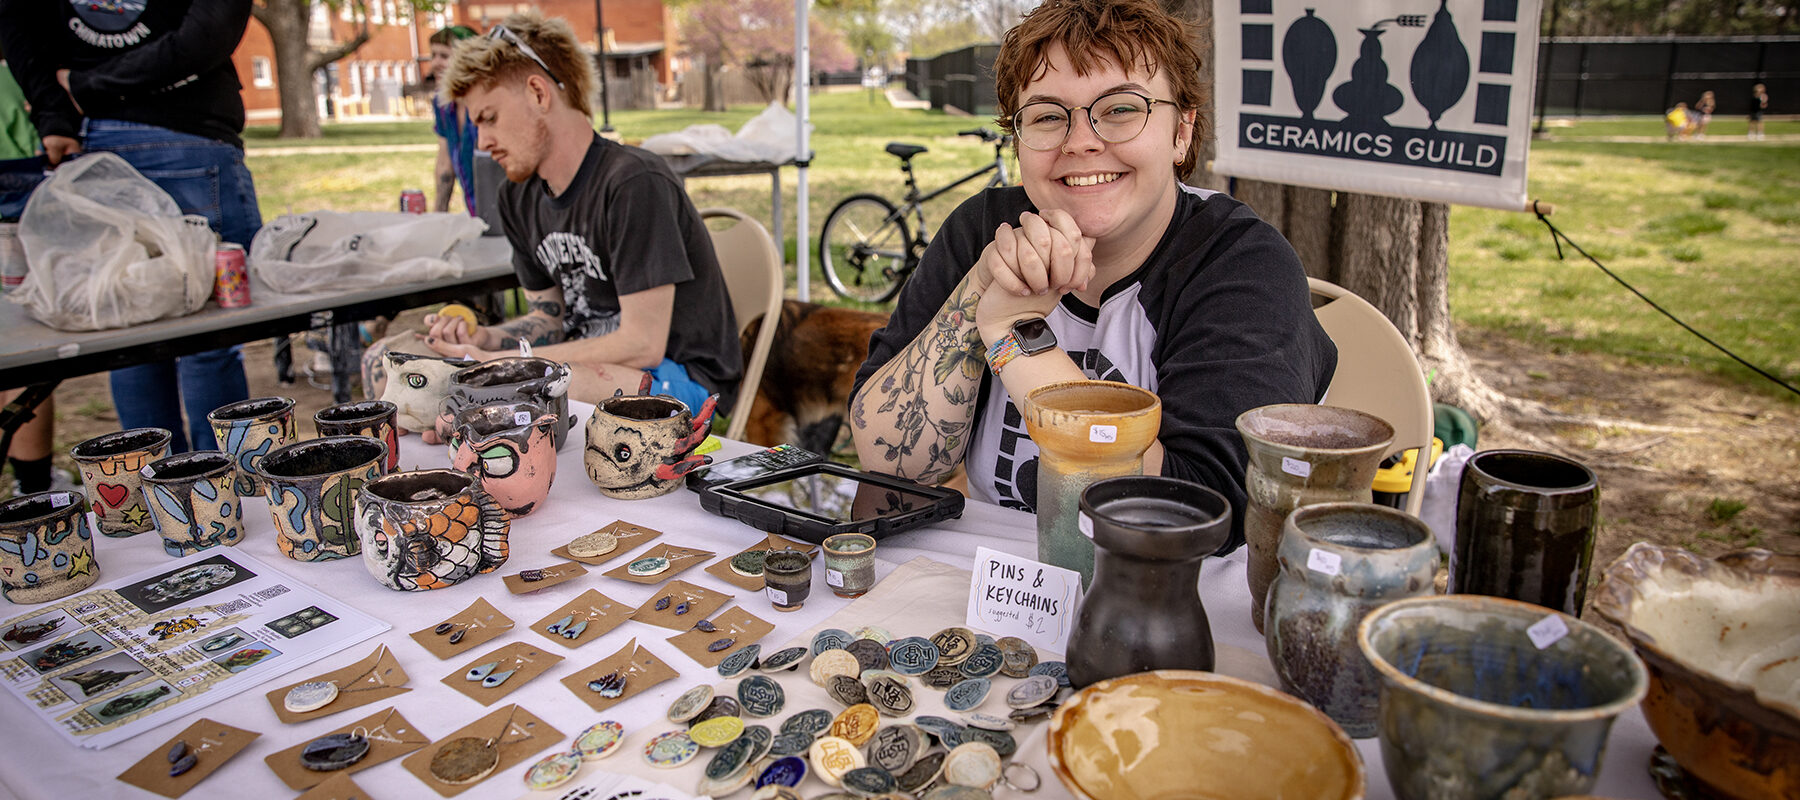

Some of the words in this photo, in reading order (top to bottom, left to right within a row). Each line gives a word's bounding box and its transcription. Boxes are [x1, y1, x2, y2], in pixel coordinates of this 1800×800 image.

[68, 16, 151, 49] CHINATOWN
[1246, 122, 1393, 158] CERAMICS
[1404, 137, 1498, 168] GUILD
[989, 560, 1025, 582] PINS
[1032, 568, 1044, 588] &
[988, 608, 1020, 622] suggested
[1025, 613, 1046, 634] $2
[157, 653, 185, 672] Ceramics
